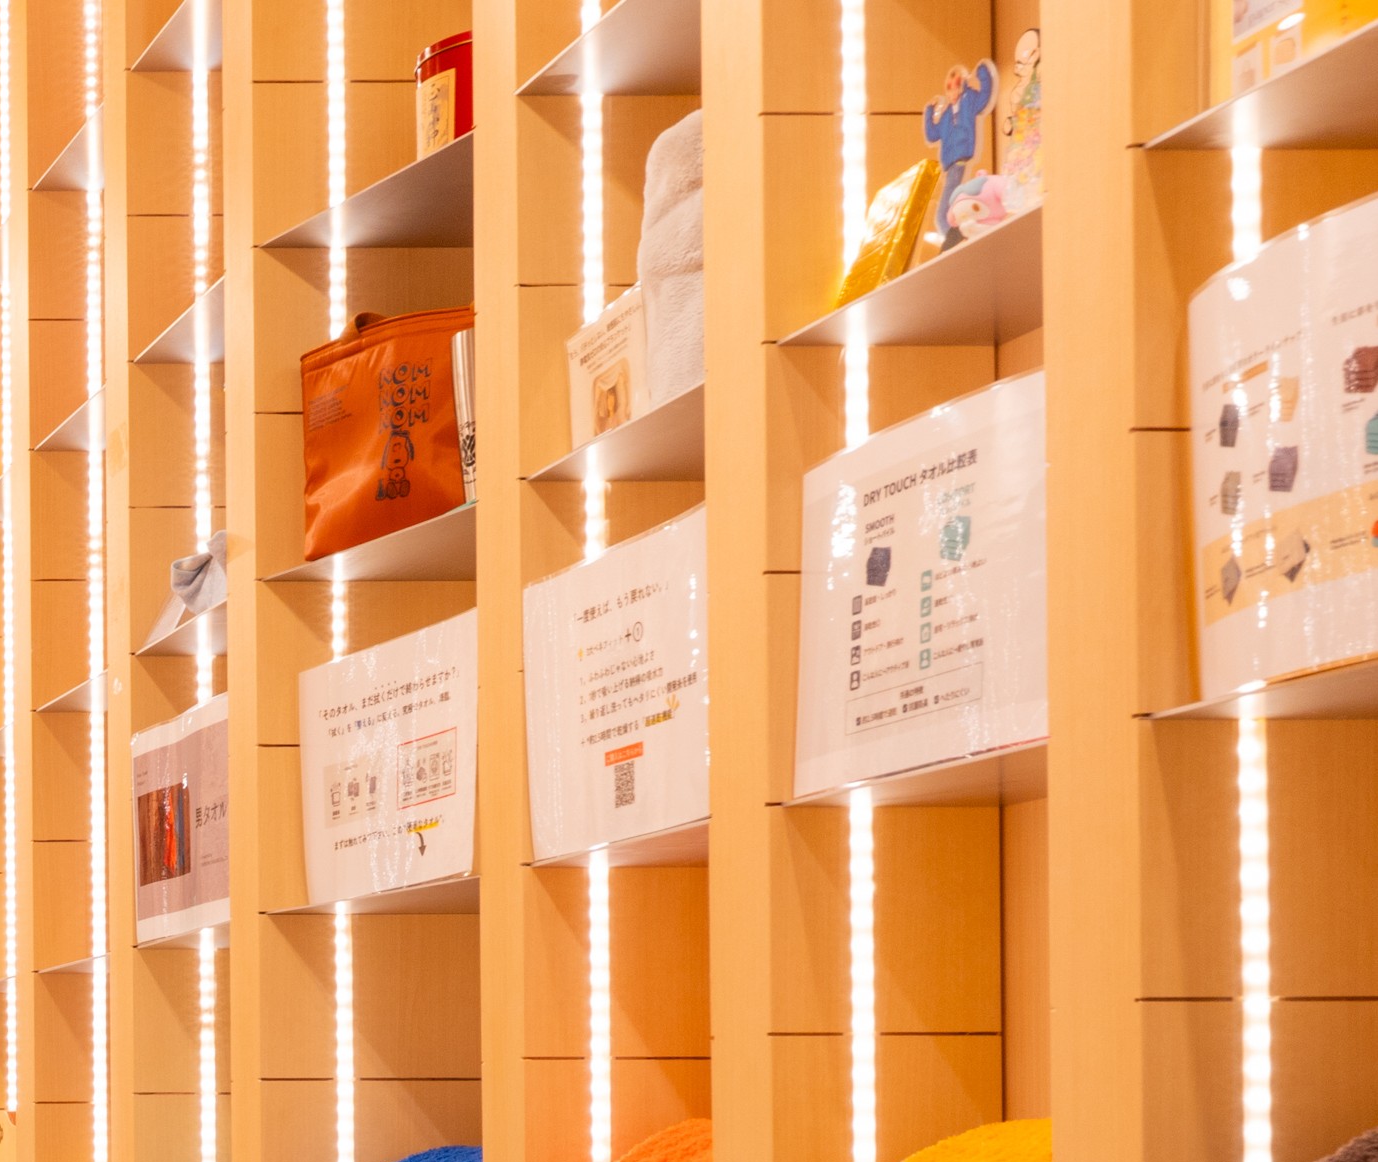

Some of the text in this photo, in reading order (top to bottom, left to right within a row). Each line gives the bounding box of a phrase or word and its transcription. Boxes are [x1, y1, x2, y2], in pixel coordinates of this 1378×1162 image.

[862, 447, 979, 508] DRY TOUCH タオル比較表
[864, 513, 896, 535] SMOOTH
